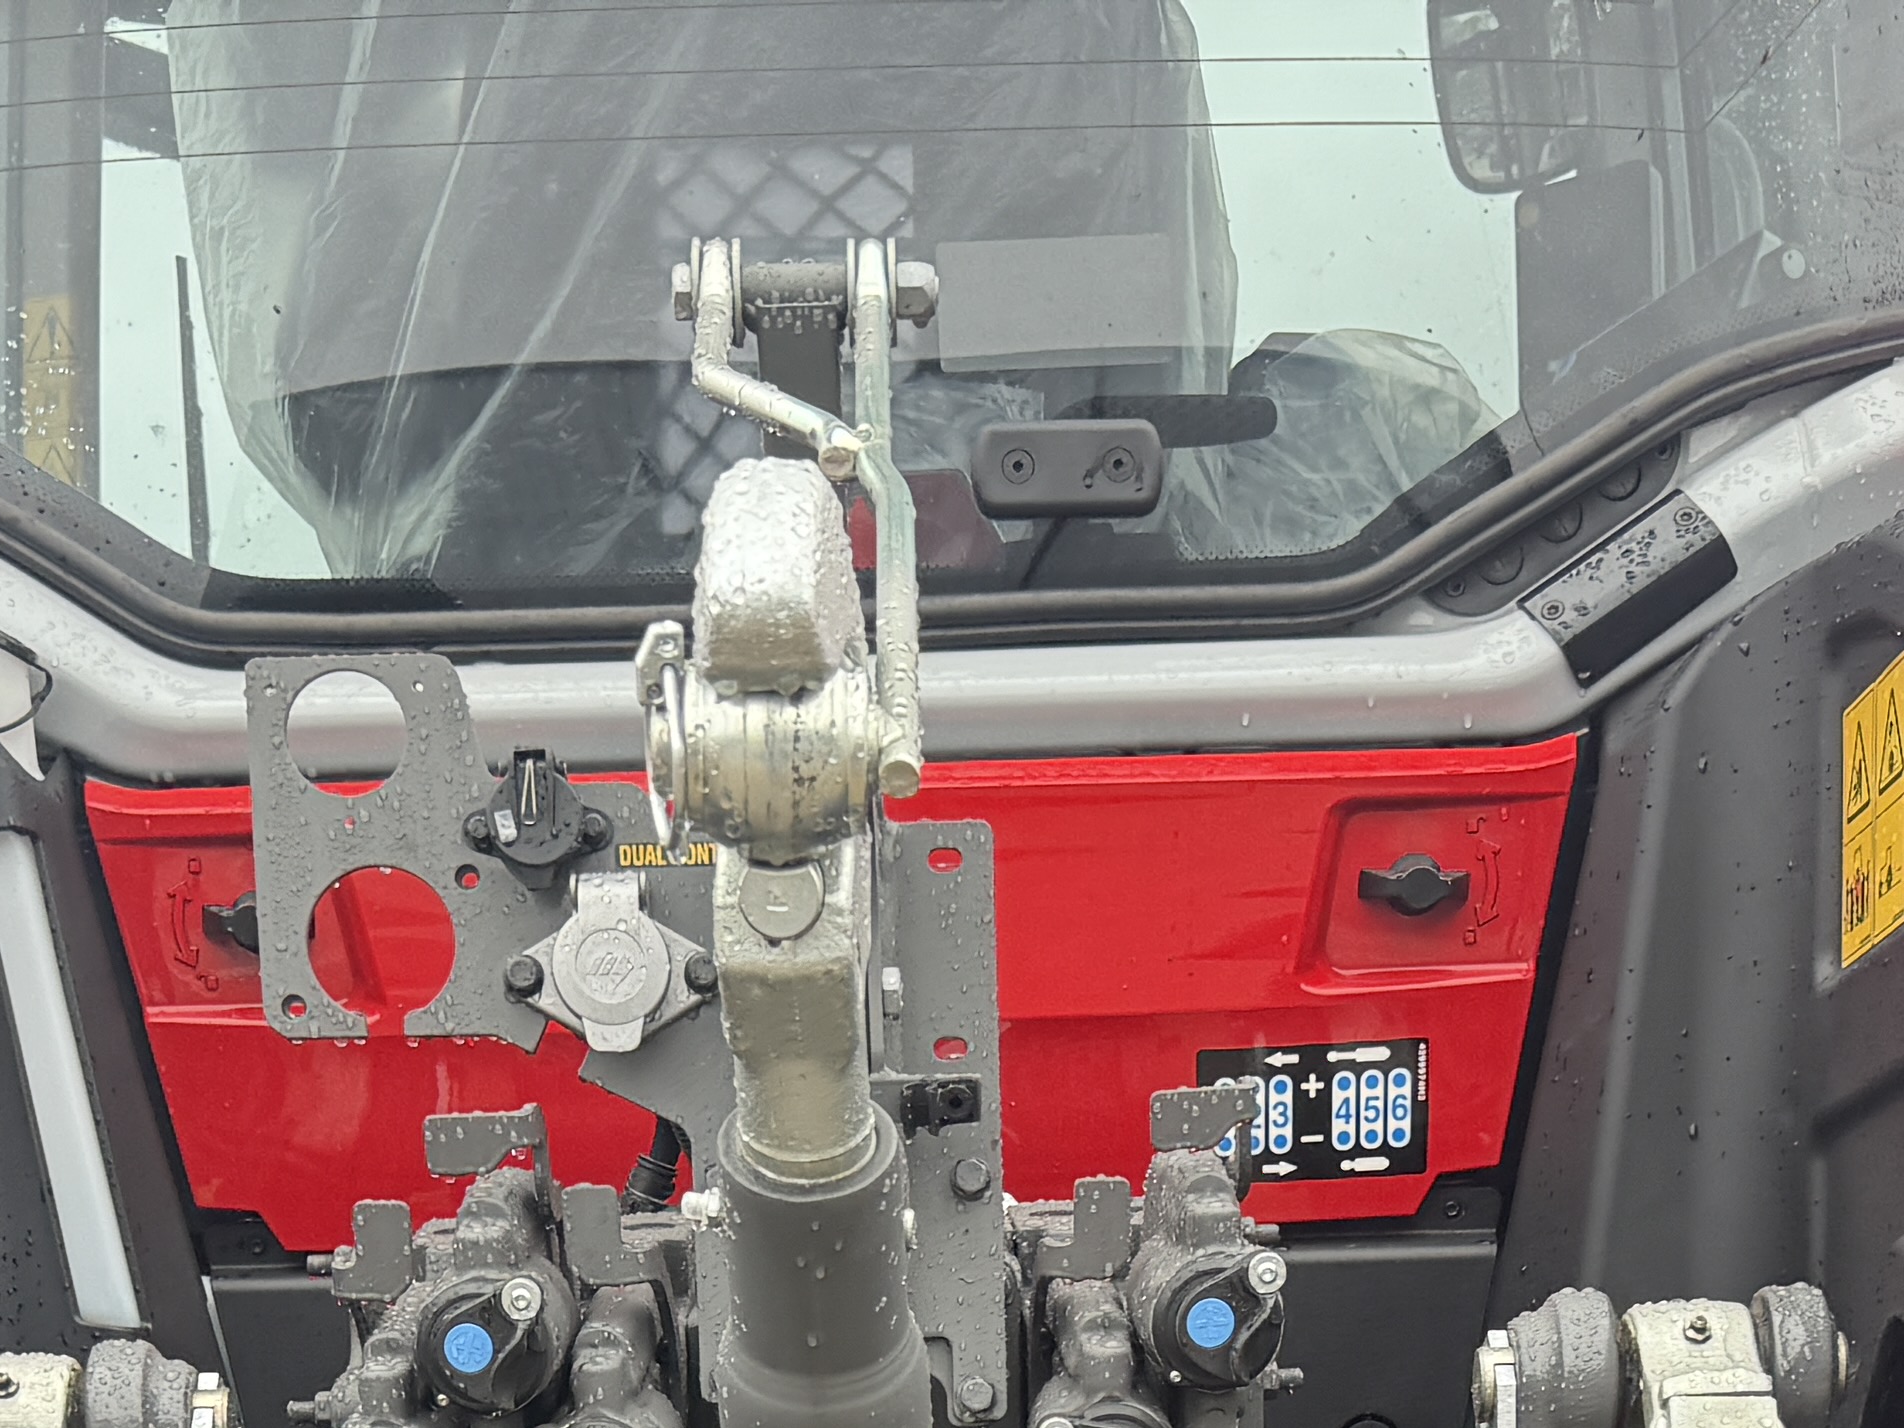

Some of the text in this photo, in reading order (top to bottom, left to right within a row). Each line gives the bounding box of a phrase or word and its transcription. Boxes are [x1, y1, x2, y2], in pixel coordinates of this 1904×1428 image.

[618, 844, 667, 866] DUAL
[1272, 1094, 1408, 1128] 3 4 5 6
